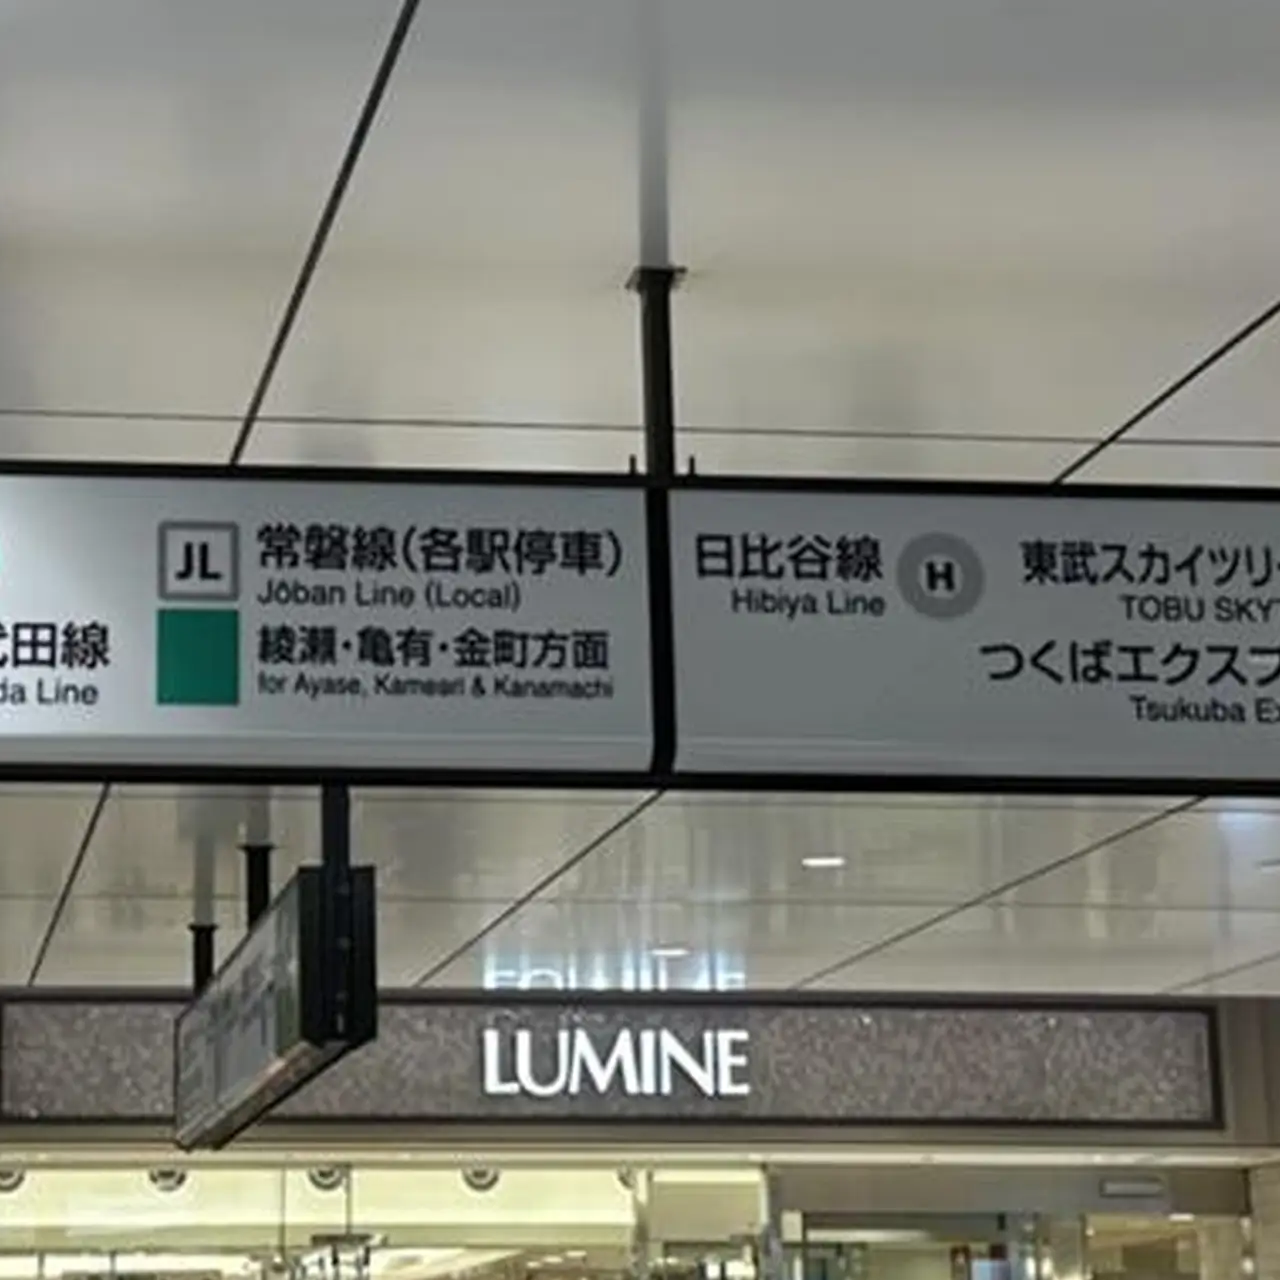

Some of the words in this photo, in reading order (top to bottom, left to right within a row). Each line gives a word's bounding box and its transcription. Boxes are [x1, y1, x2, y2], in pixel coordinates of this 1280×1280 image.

[175, 541, 222, 580] JL
[257, 522, 621, 577] 常磐線(各駅停車)
[695, 532, 883, 582] 日比谷線
[925, 561, 956, 592] H
[356, 579, 415, 608] Line
[425, 580, 521, 613] (Local)
[731, 587, 818, 619] Hibiya
[827, 588, 886, 617] Line
[1121, 594, 1206, 622] TOBU
[257, 625, 609, 670] 綾瀬・亀有・金町方面
[36, 677, 99, 706] Line
[257, 672, 286, 695] for
[472, 676, 485, 699] &
[1130, 694, 1246, 723] Tsukuba
[483, 1027, 751, 1097] LUMINE
